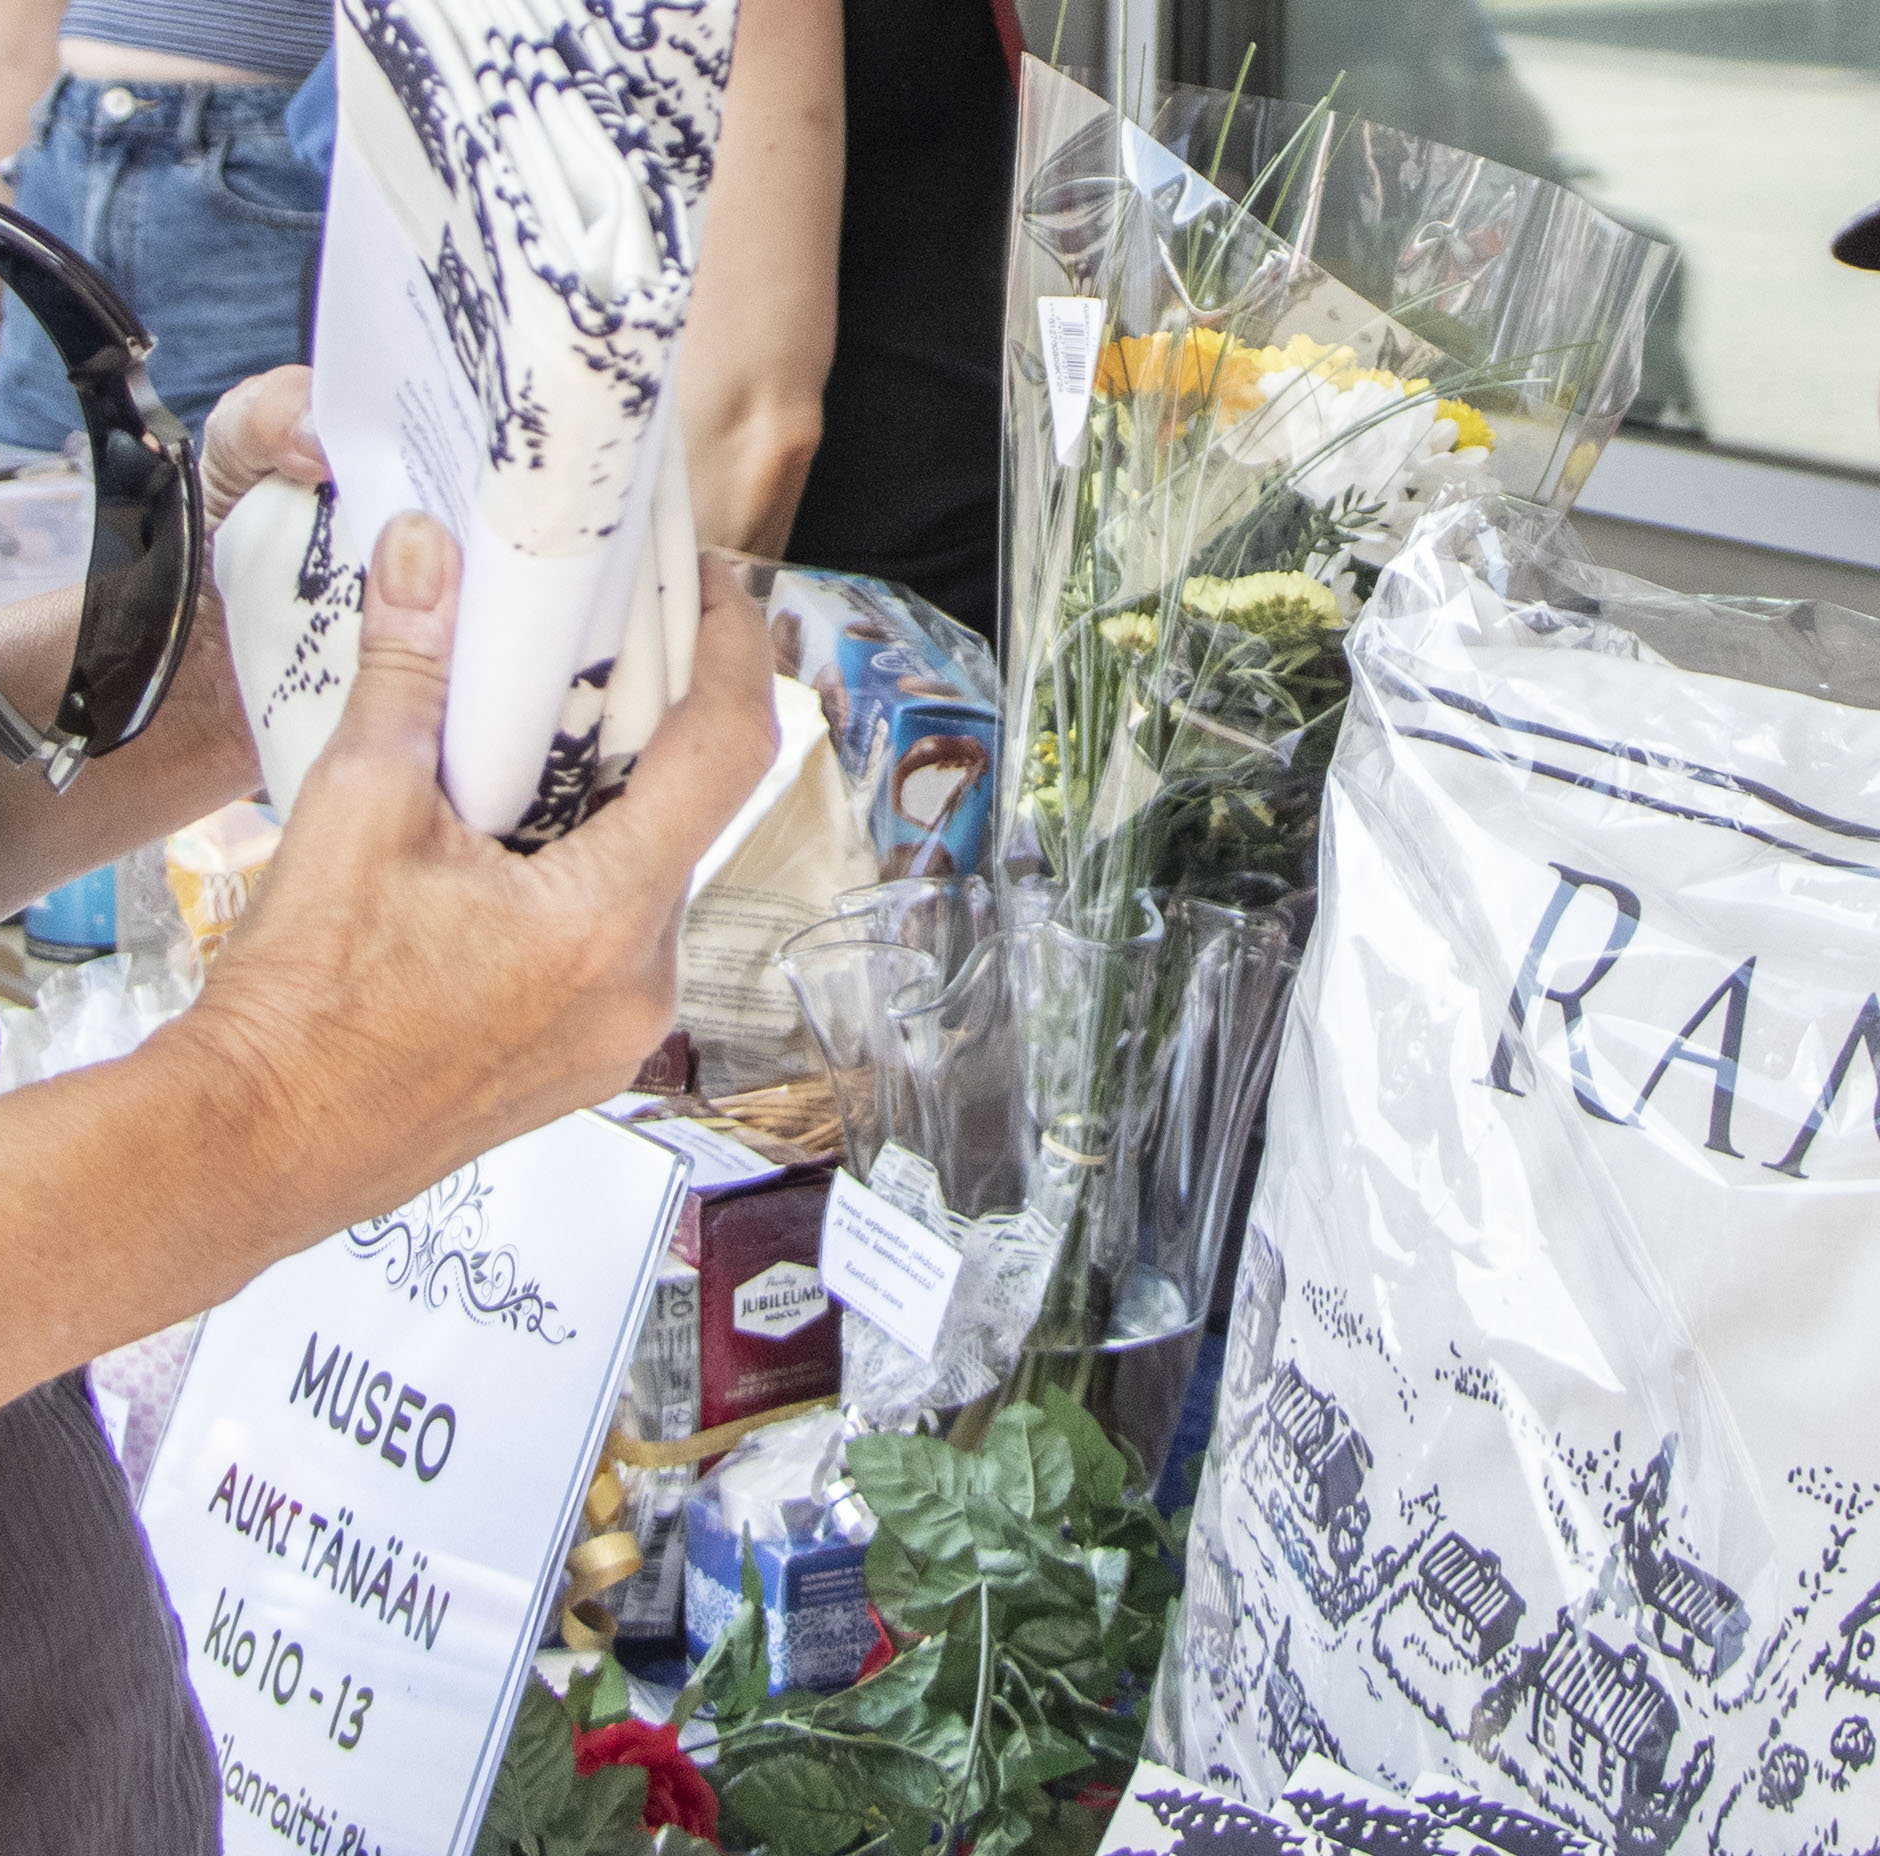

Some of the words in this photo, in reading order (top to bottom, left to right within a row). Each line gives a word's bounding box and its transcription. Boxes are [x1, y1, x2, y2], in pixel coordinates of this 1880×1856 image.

[741, 1284, 823, 1318] JUBILEUMS
[289, 1331, 456, 1482] MUSEO
[208, 1462, 303, 1557] AUKI
[302, 1506, 450, 1651] TÄNÄÄN
[203, 1586, 256, 1677] klo
[258, 1628, 304, 1705] 10
[328, 1674, 374, 1750] 13
[219, 1733, 338, 1856] ilanraitti
